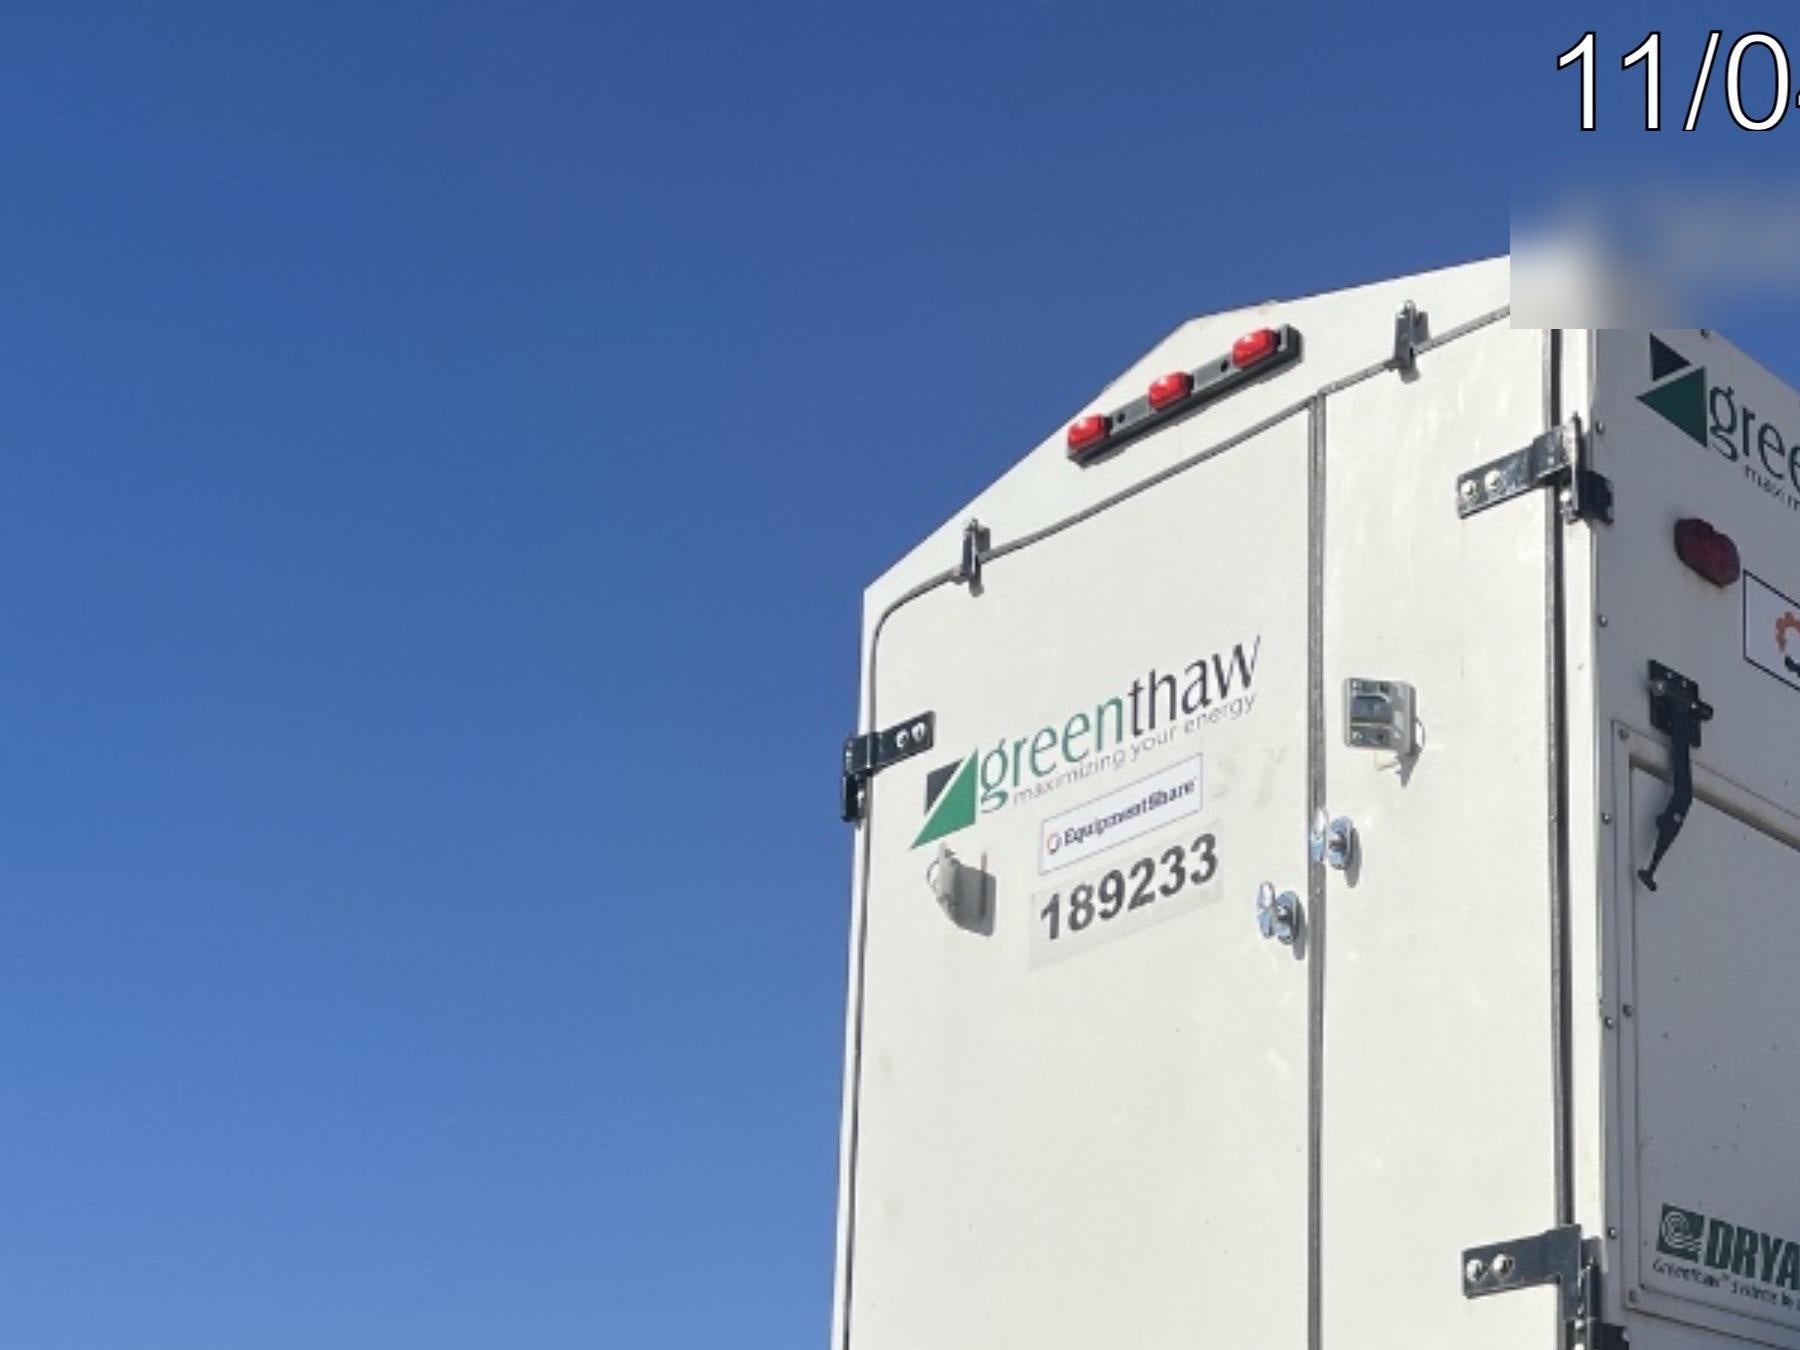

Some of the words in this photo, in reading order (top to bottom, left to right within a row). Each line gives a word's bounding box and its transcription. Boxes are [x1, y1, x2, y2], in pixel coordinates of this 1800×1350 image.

[980, 635, 1260, 814] greenthaw
[1014, 749, 1126, 806] maximizing
[1130, 726, 1177, 760] your
[1183, 692, 1257, 734] energy
[1040, 833, 1218, 940] 189233
